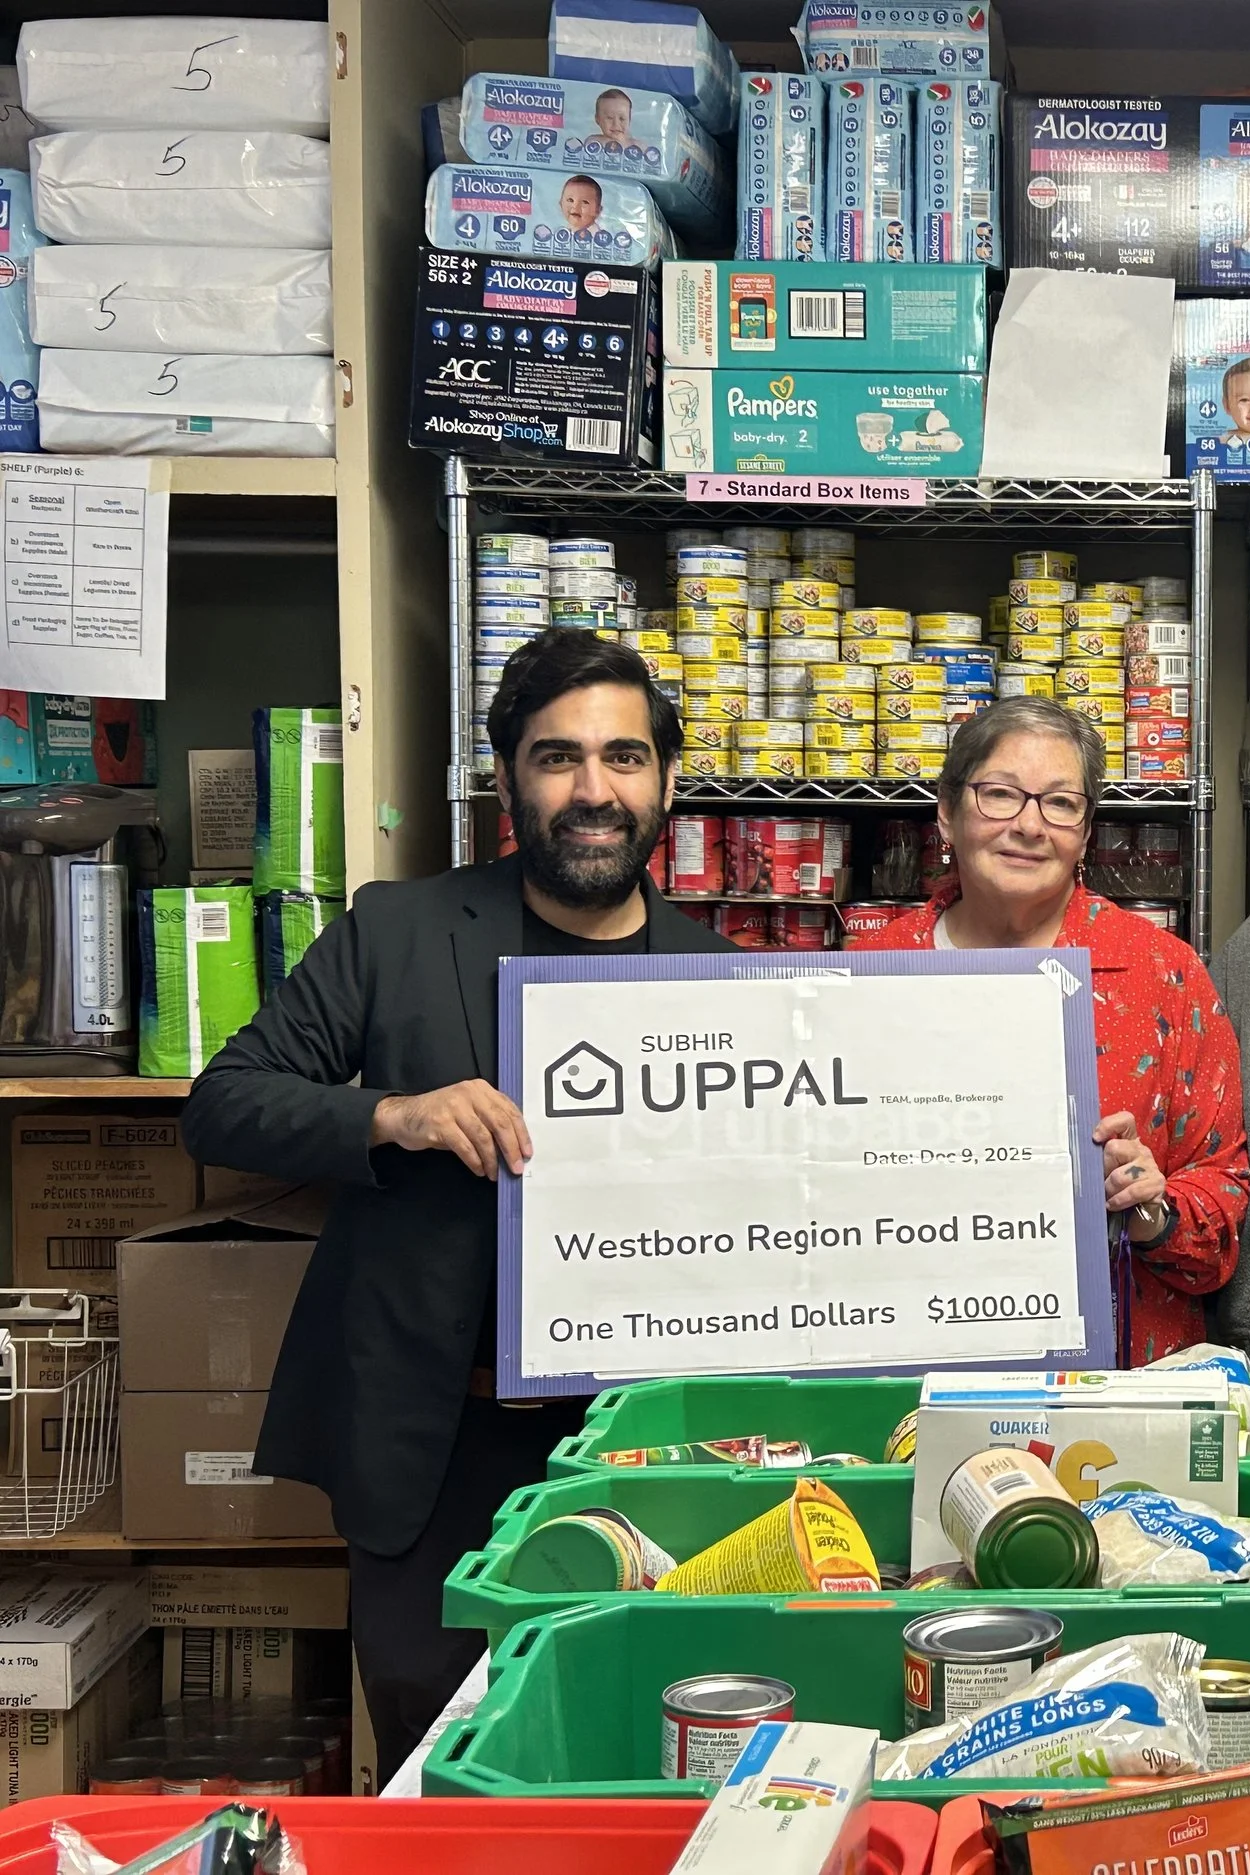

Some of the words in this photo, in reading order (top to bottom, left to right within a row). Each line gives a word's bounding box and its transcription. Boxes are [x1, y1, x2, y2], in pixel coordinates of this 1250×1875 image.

[171, 35, 239, 91] 5
[487, 89, 564, 115] Alokozay
[489, 127, 512, 146] 4+
[532, 131, 551, 145] 56
[1034, 114, 1167, 151] Alokozay
[155, 133, 198, 176] 5
[454, 177, 532, 201] Alokozay
[500, 218, 519, 233] 60
[1123, 218, 1150, 237] 112
[428, 254, 459, 270] SIZE
[461, 256, 478, 270] 4+
[428, 269, 447, 284] 56
[461, 272, 472, 285] 2
[485, 269, 578, 299] Alokozay
[94, 281, 128, 331] 5
[435, 322, 445, 336] 1
[463, 325, 474, 339] 2
[491, 327, 501, 340] 3
[517, 329, 529, 343] 4
[543, 325, 569, 348] 4+
[582, 333, 593, 348] 5
[609, 337, 620, 351] 6
[147, 357, 184, 396] 5
[438, 357, 492, 382] AGC
[867, 385, 891, 396] use
[893, 384, 949, 398] together
[727, 386, 818, 421] Pampers
[468, 409, 495, 422] Shop
[495, 410, 528, 423] Online
[528, 414, 540, 424] at
[798, 429, 808, 442] 2
[0, 463, 33, 473] SHELF
[34, 465, 73, 476] (Purple)
[698, 480, 708, 496] 7
[727, 480, 812, 499] Standard
[817, 482, 855, 499] Box
[859, 483, 910, 500] Items
[640, 1032, 734, 1053] SUBHIR
[641, 1057, 868, 1113] UPPAL
[955, 1094, 1004, 1103] Brokerage
[106, 1128, 169, 1144] F-6024
[52, 1160, 92, 1172] SLICED
[94, 1160, 145, 1172] PEACHES
[863, 1150, 915, 1166] Date:
[921, 1148, 956, 1164] Dec
[961, 1148, 979, 1165] 9,
[984, 1147, 1033, 1162] 2025
[43, 1184, 87, 1200] PÊCHES
[89, 1184, 155, 1200] TRANCHÉES
[66, 1217, 82, 1230] 24
[120, 1216, 134, 1229] ml
[554, 1231, 735, 1261] Westboro
[748, 1220, 862, 1255] Region
[875, 1216, 959, 1245] Food
[972, 1212, 1058, 1241] Bank
[549, 1317, 614, 1342] One
[622, 1305, 779, 1338] Thousand
[791, 1302, 896, 1329] Dollars
[927, 1293, 1060, 1324] $1000.00
[989, 1419, 1050, 1436] QUAKER
[152, 1603, 174, 1613] THON
[177, 1602, 199, 1613] PÂLE
[239, 1606, 262, 1615] DANS
[264, 1605, 289, 1615] L'EAU
[17, 1656, 38, 1667] 170g
[942, 1721, 1022, 1768] GRAINS
[1031, 1699, 1107, 1728] LONGS
[955, 1705, 1023, 1744] WHITE
[9, 1741, 19, 1769] LIGHT
[9, 1770, 19, 1797] TUNA
[1172, 1823, 1204, 1843] Leclerc
